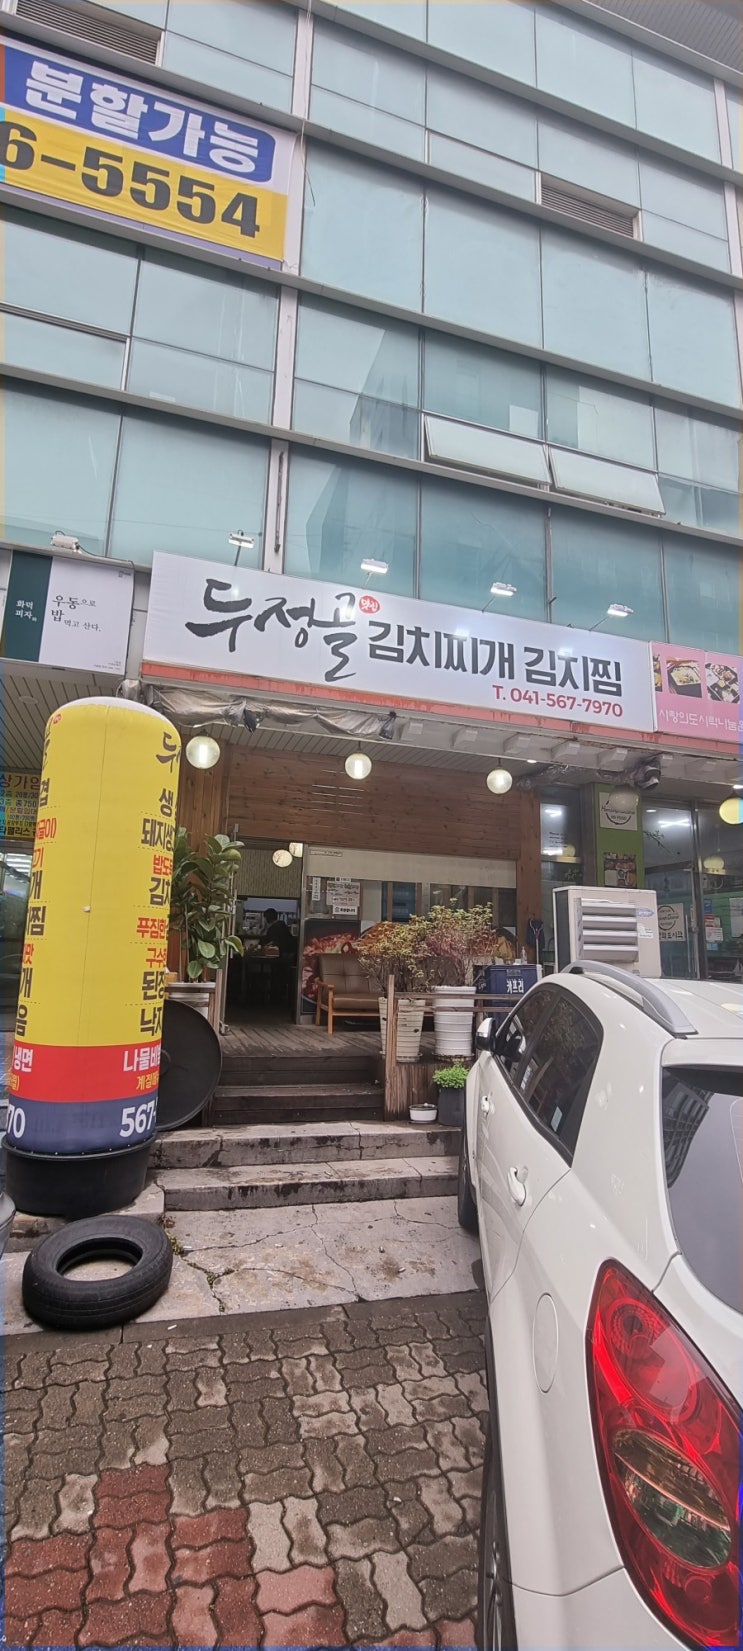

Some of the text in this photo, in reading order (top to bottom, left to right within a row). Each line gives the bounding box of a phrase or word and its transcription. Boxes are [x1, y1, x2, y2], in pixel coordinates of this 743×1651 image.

[25, 60, 260, 174] 분할가능
[0, 120, 261, 239] 6-5554
[51, 609, 65, 622] 밥
[52, 595, 97, 610] 우동으로
[185, 578, 358, 683] 두정골
[368, 620, 623, 697] 김치찌개 김치찜
[492, 684, 623, 717] T. 041-567-7970
[26, 906, 47, 936] 찜
[146, 948, 167, 969] 구수
[120, 1097, 158, 1138] 567-
